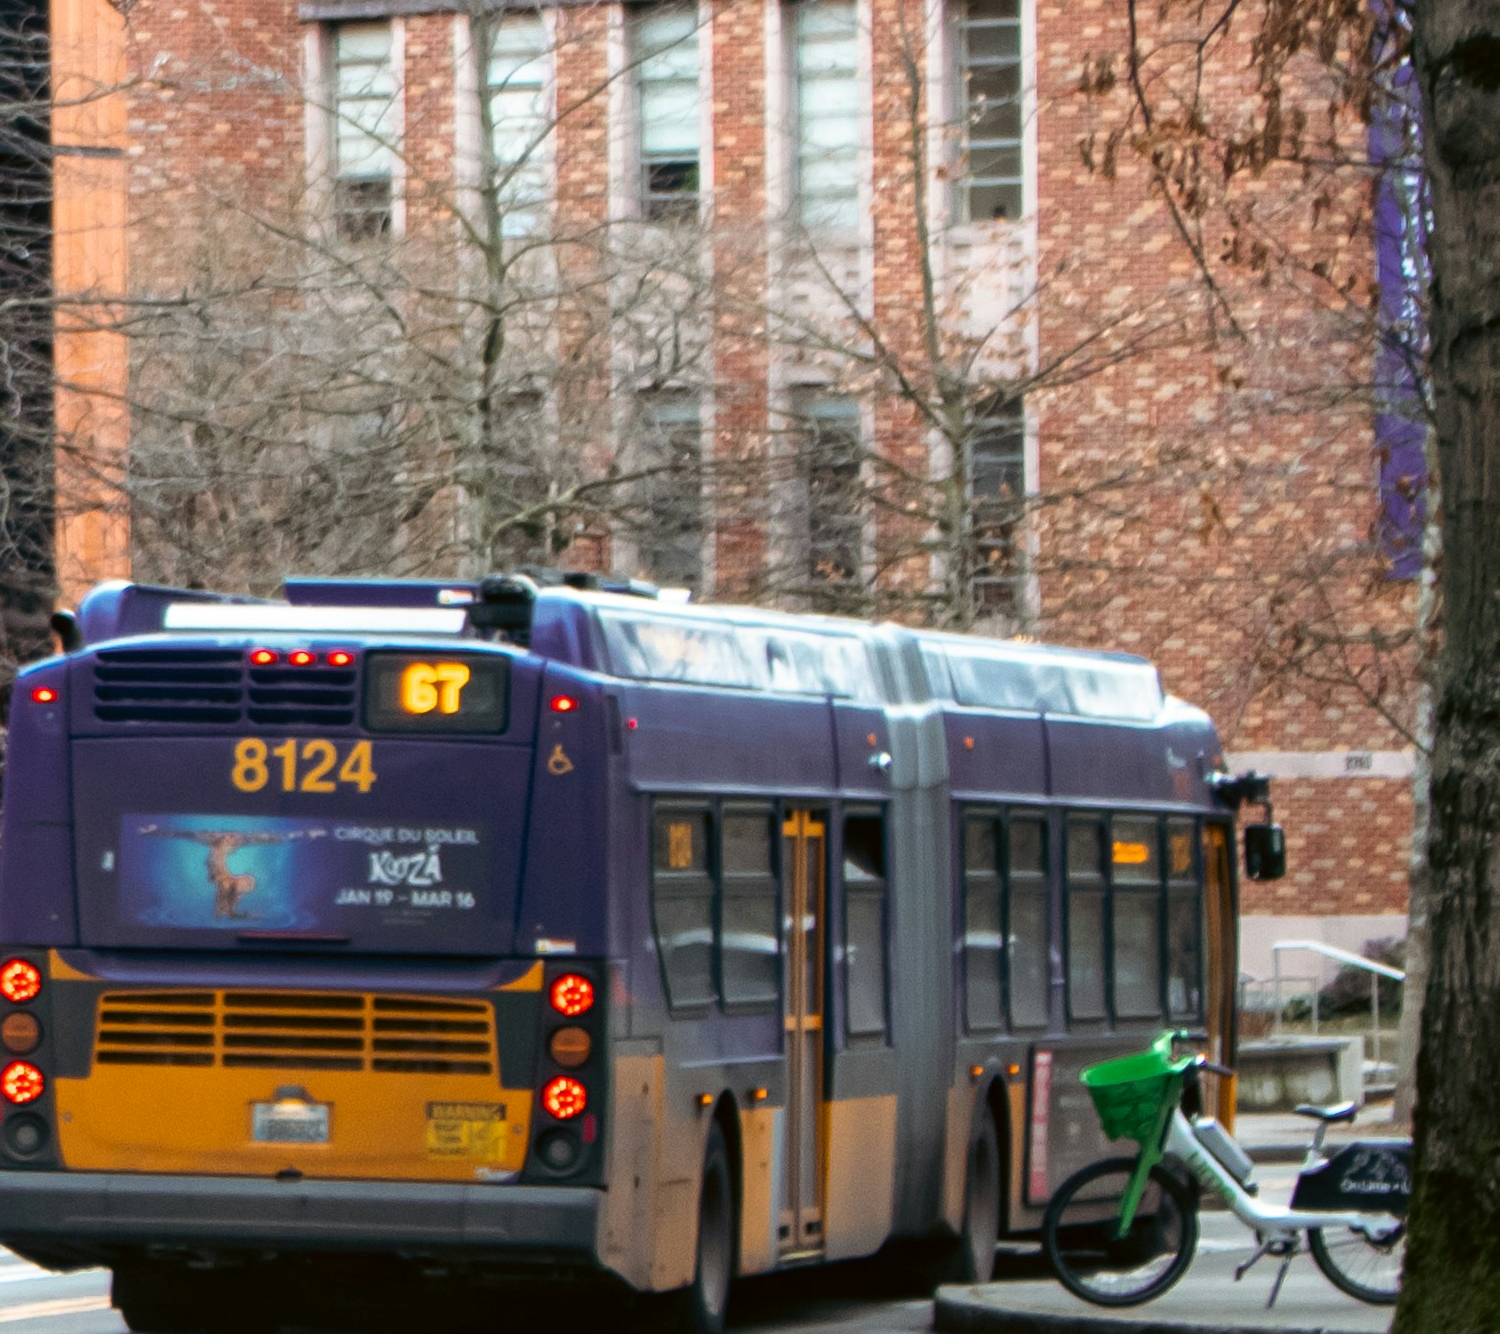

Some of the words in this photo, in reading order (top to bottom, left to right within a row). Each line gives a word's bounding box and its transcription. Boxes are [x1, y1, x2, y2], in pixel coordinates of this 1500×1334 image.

[403, 662, 470, 714] 67
[232, 737, 377, 793] 8124
[334, 827, 394, 845] CIRQUE
[397, 828, 421, 843] DU
[424, 828, 479, 845] SOLEIL
[335, 889, 371, 906] JAN
[411, 890, 453, 908] MAR
[456, 890, 476, 909] 16
